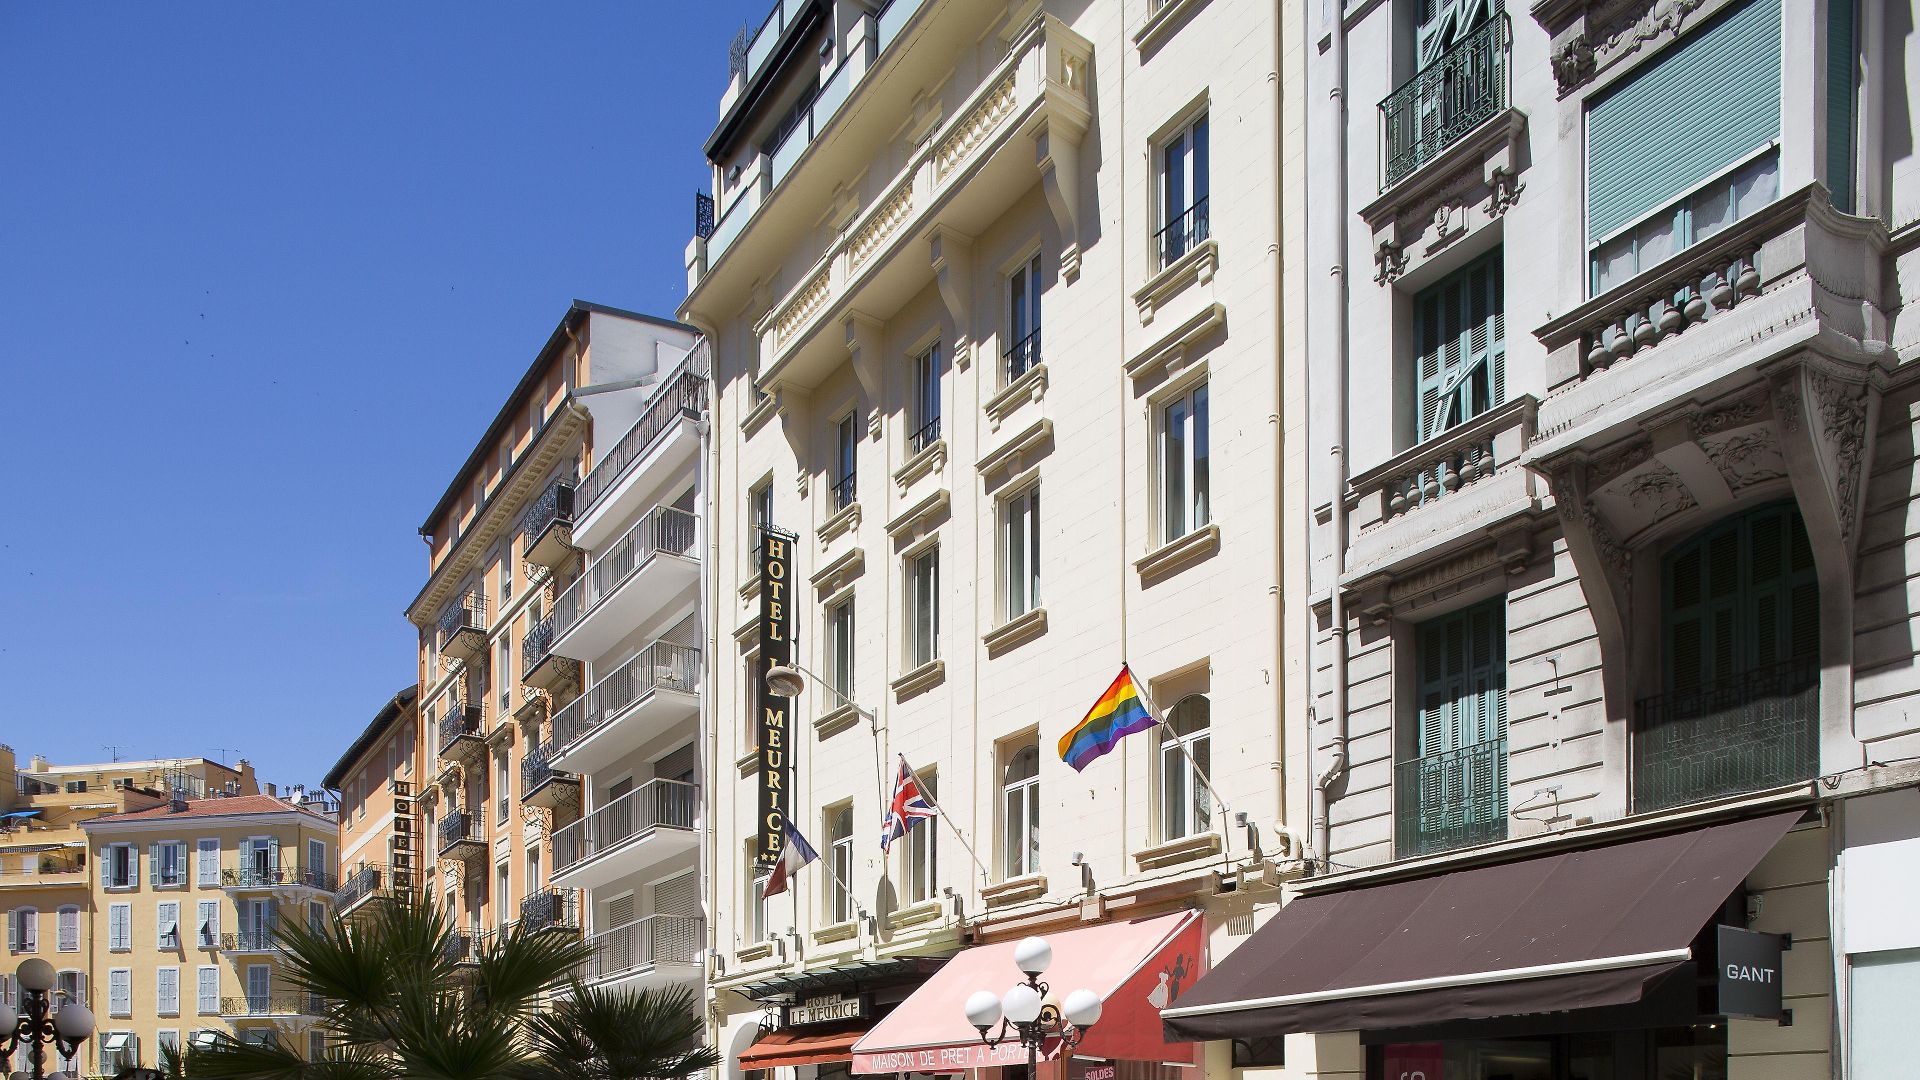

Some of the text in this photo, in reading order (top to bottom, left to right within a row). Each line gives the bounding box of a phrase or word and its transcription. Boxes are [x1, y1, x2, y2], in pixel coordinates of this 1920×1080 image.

[767, 539, 785, 641] HOTEL
[765, 708, 784, 851] MEURICE
[398, 783, 408, 865] HOTEL
[1727, 964, 1774, 983] GANT
[806, 993, 842, 1008] HOTEL
[792, 1002, 858, 1025] LE MEURICE
[871, 1043, 1042, 1070] MAISON DE PRET A PORTE
[1085, 1066, 1114, 1080] SOLDES
